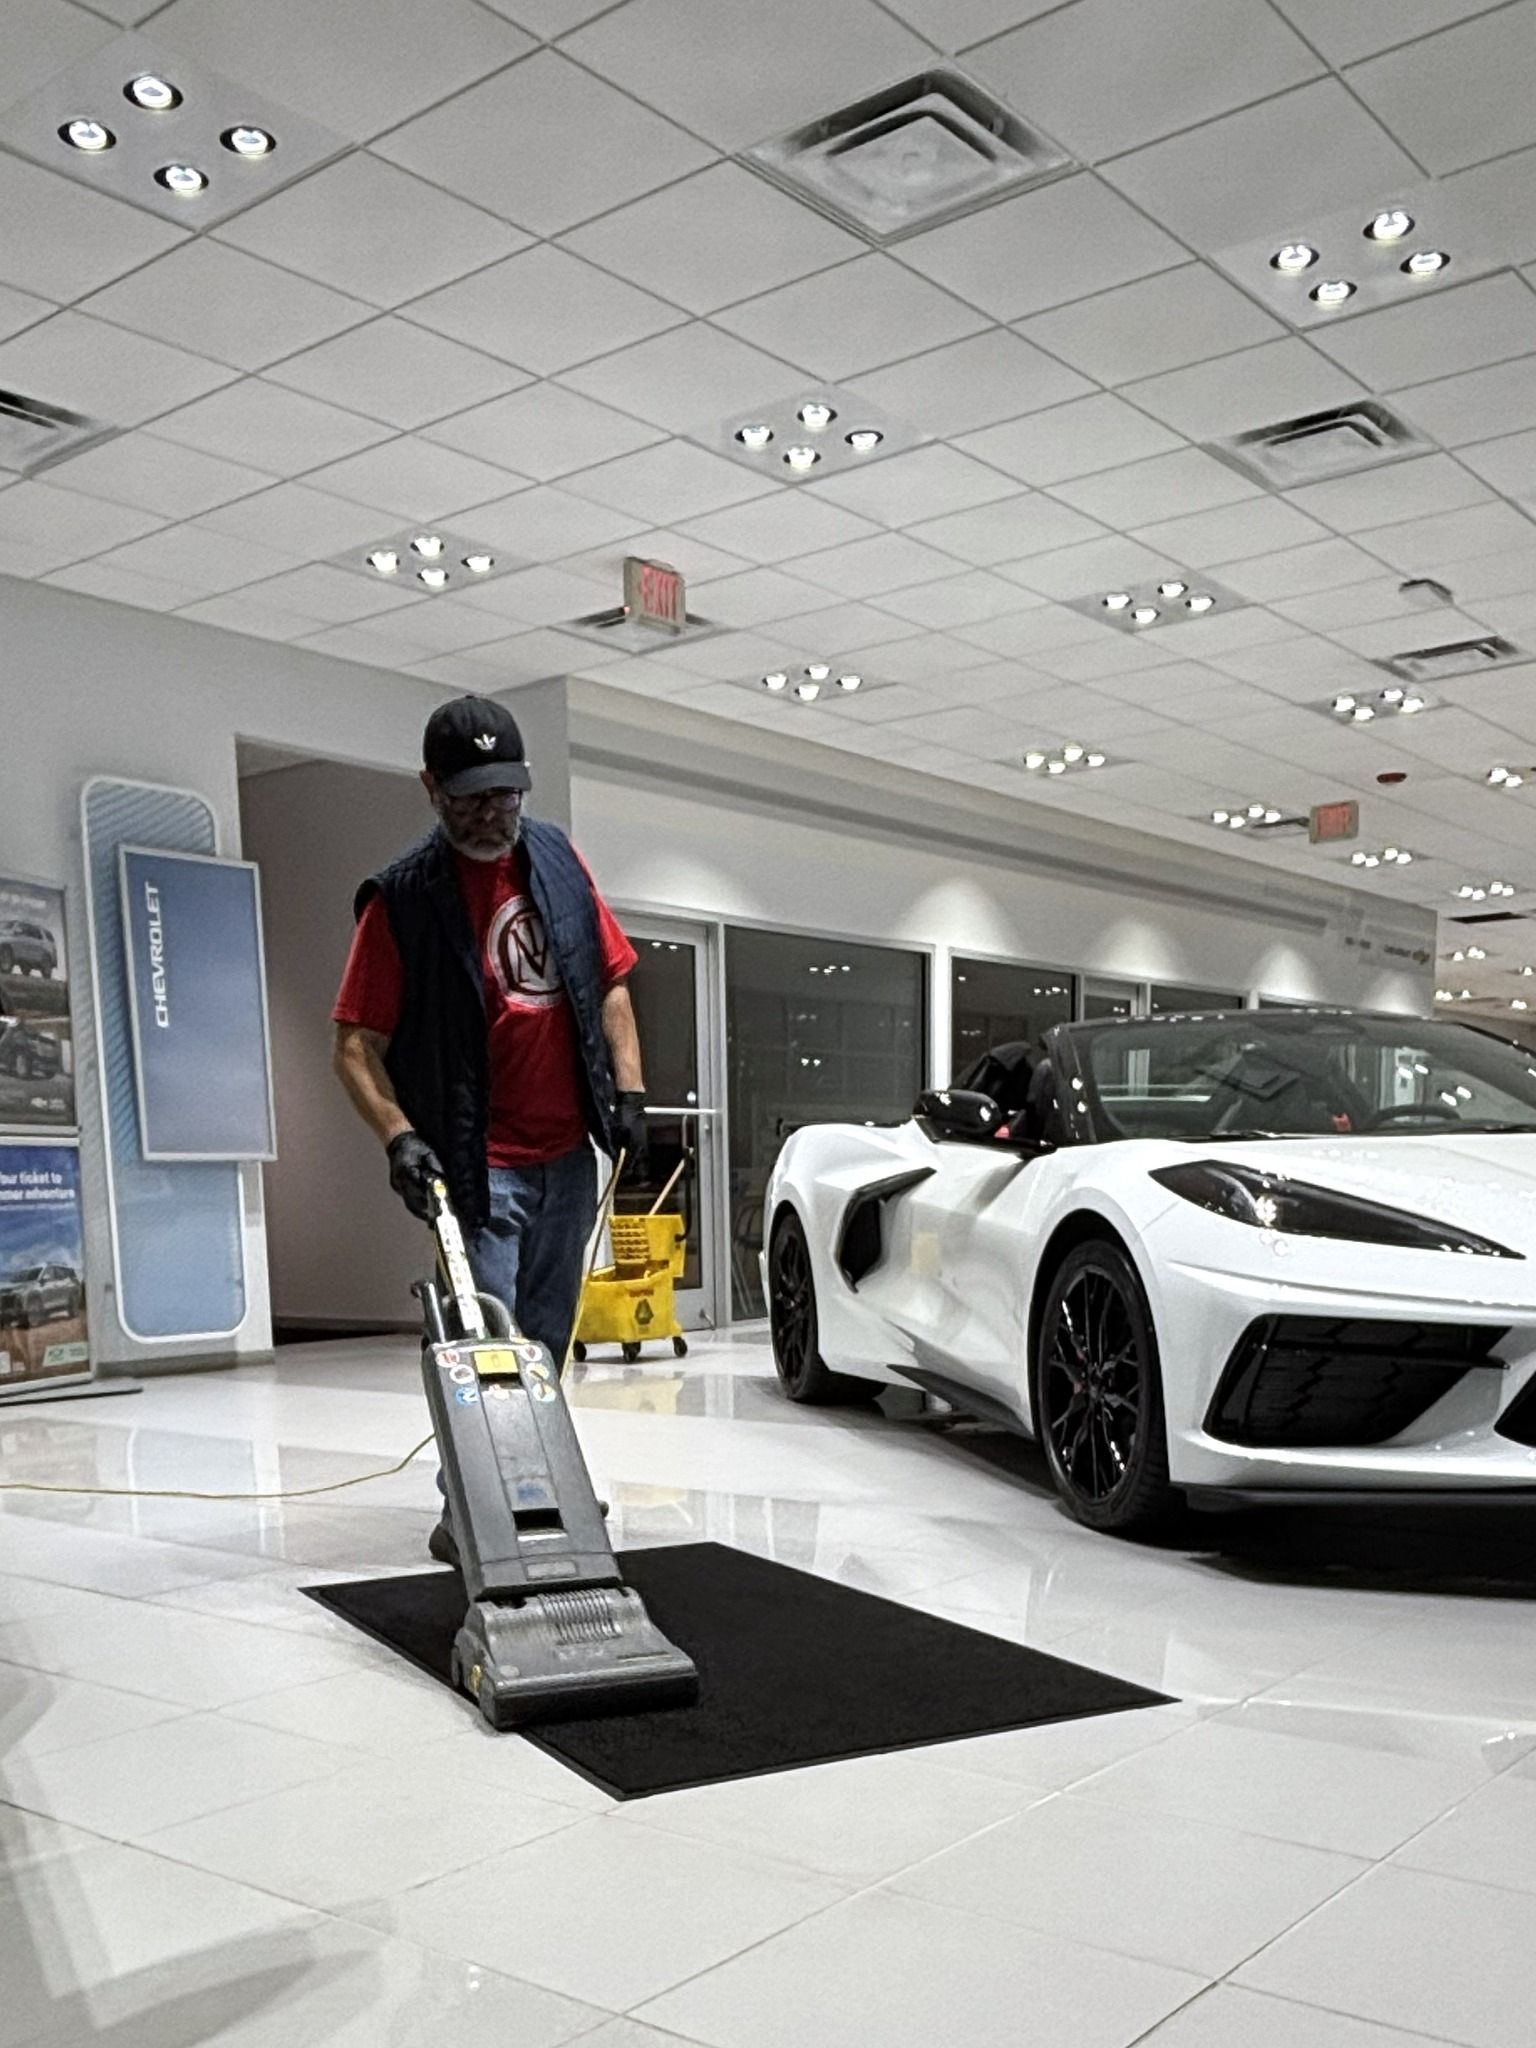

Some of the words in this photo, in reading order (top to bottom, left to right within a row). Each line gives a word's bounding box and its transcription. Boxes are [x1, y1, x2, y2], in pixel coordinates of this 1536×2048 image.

[144, 881, 170, 1028] CHEVROLET
[0, 1171, 18, 1187] our
[19, 1170, 49, 1186] ticket
[50, 1171, 63, 1186] to
[25, 1187, 75, 1200] adventure
